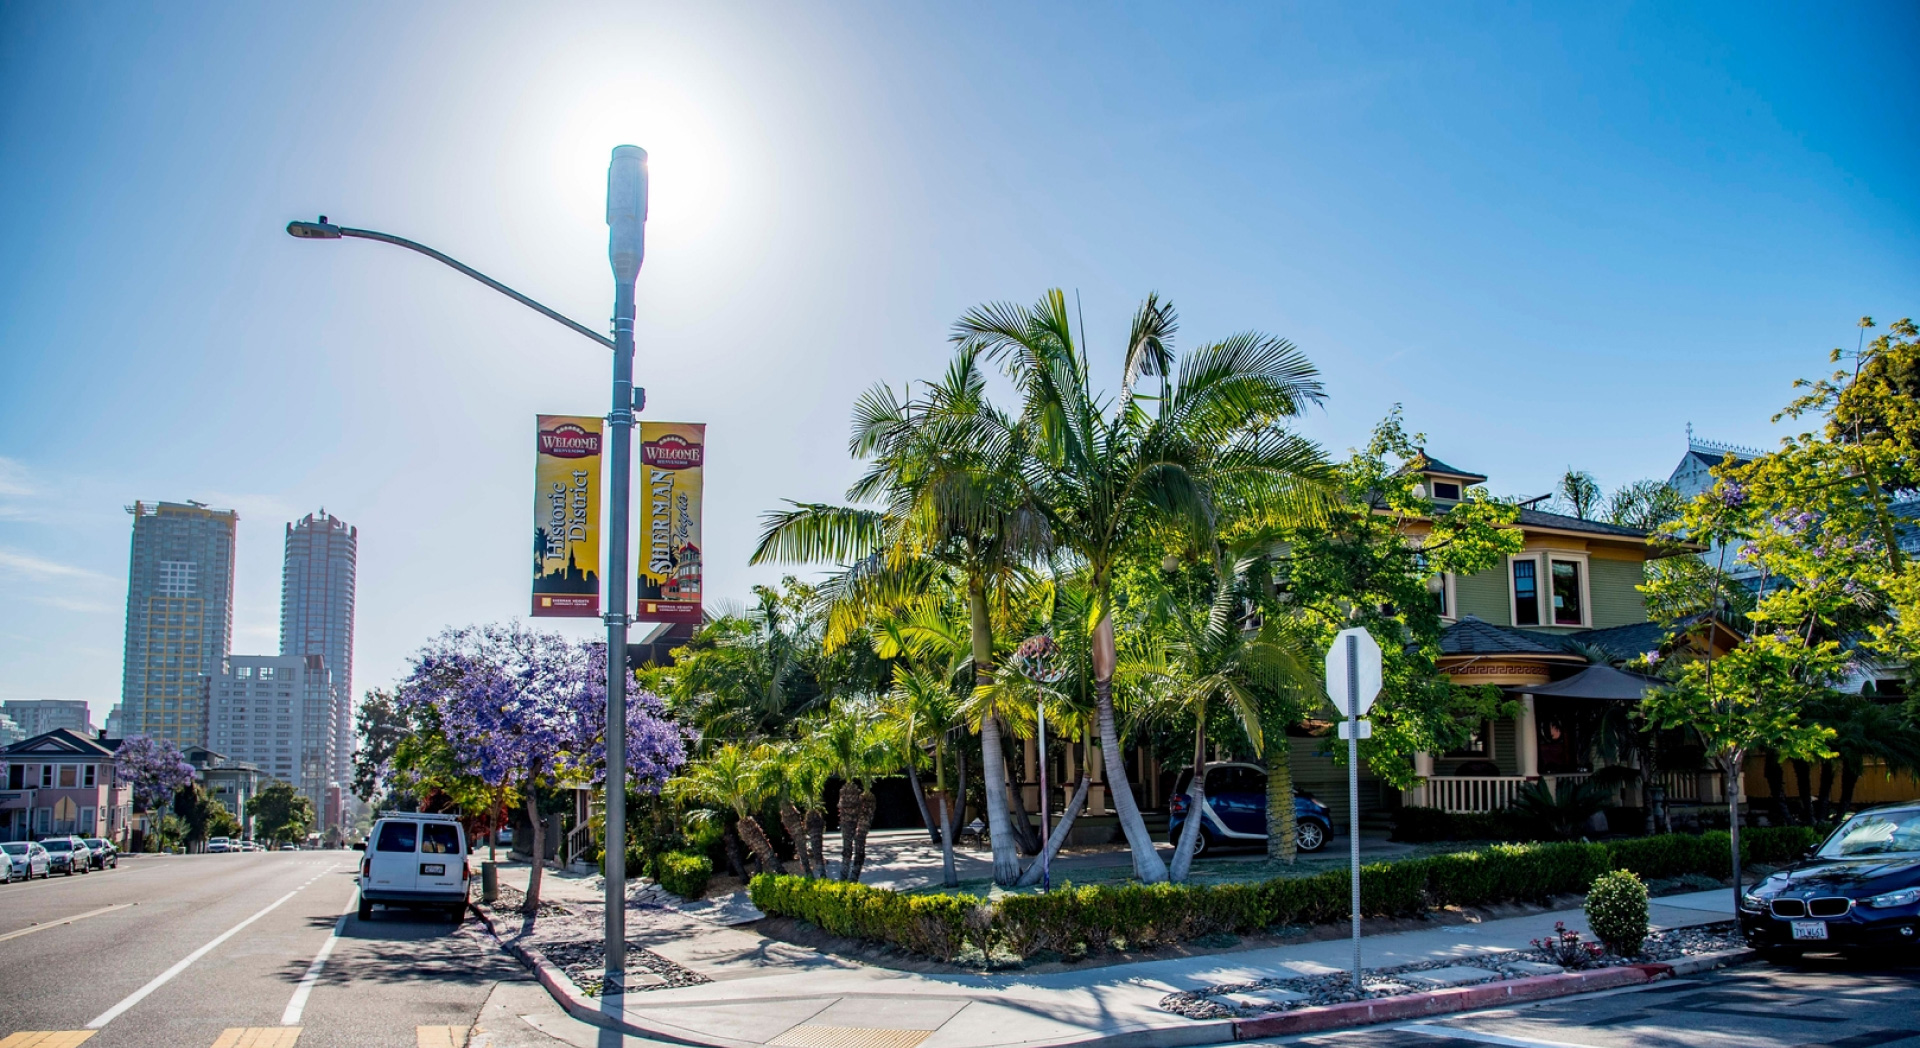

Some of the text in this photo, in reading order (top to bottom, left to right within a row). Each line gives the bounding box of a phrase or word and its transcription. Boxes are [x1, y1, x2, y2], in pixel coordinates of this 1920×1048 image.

[541, 435, 598, 450] WELCOME
[645, 446, 700, 461] WELCOME
[546, 482, 566, 560] Historic
[568, 469, 588, 542] District
[648, 469, 675, 575] SHERMAN
[672, 491, 693, 547] Heights
